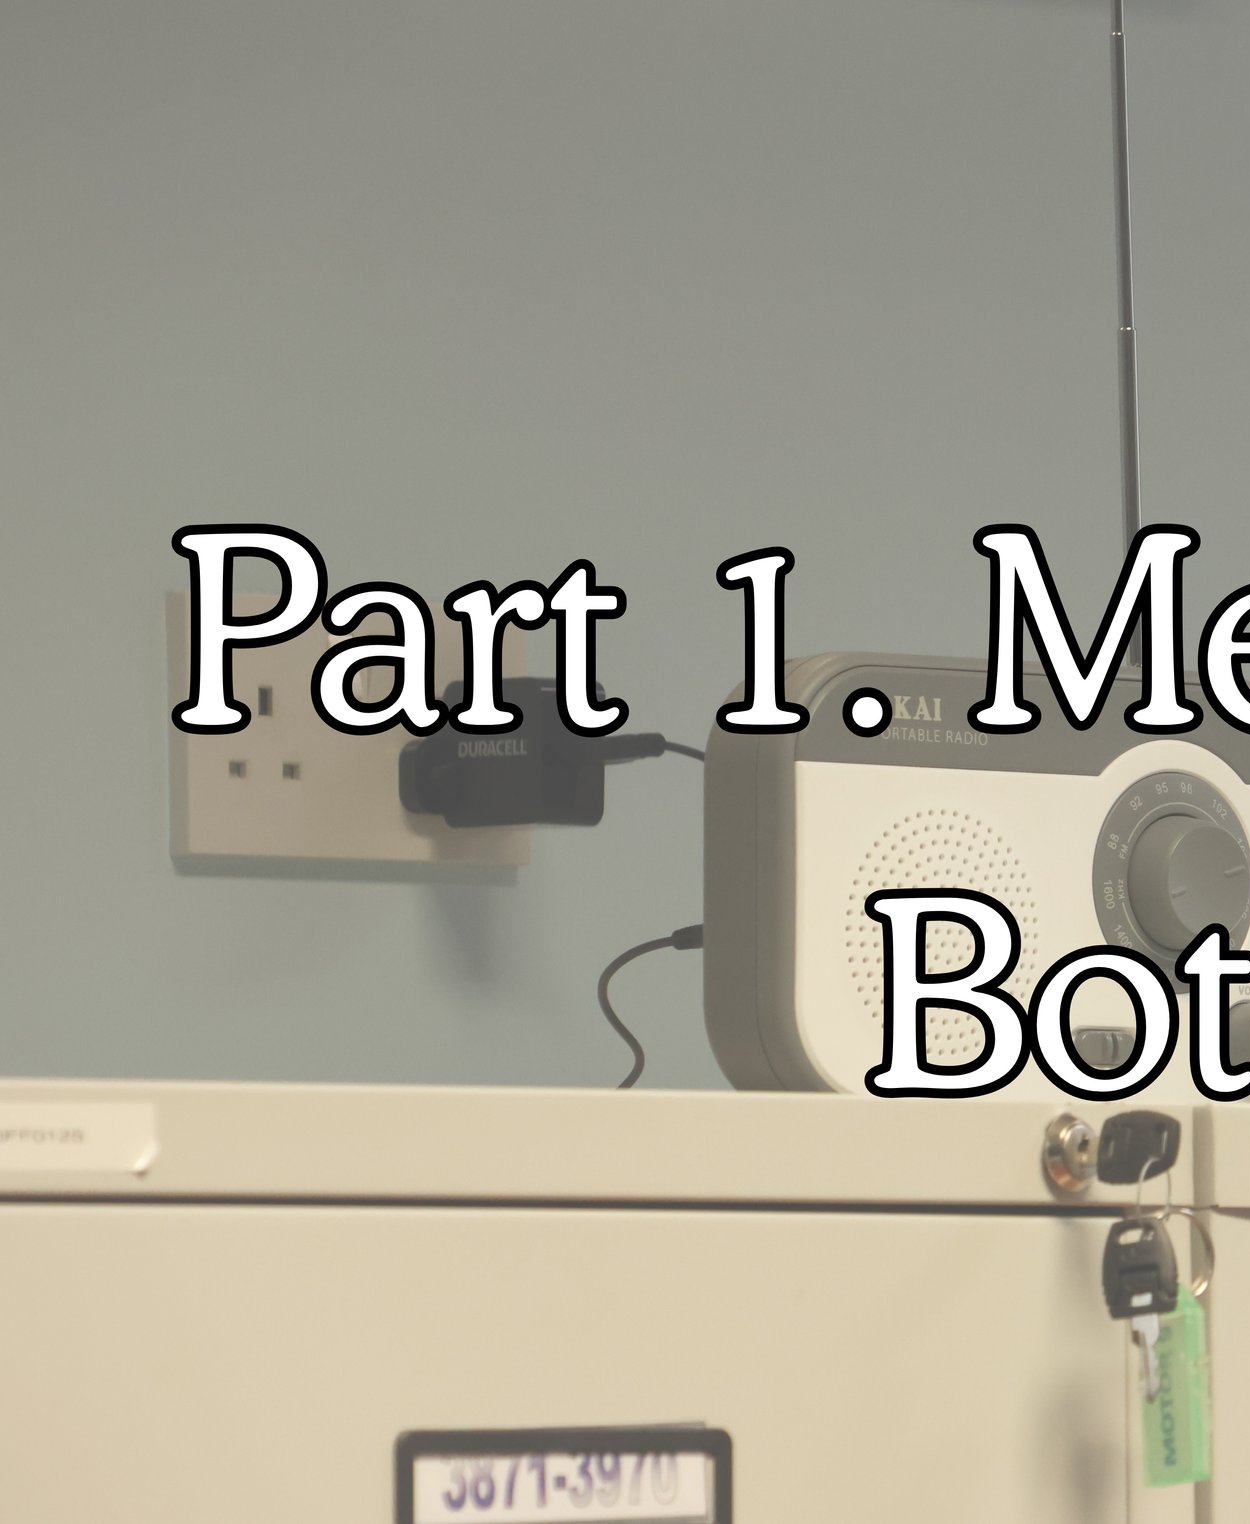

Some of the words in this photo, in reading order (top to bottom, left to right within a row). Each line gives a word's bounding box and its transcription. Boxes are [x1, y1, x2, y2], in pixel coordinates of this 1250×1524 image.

[893, 695, 942, 721] KAI
[458, 739, 527, 758] DURACELL
[882, 726, 941, 742] ORTABLE
[945, 729, 989, 746] RADIO
[1107, 833, 1119, 850] 88
[1129, 796, 1143, 811] 92
[1155, 782, 1169, 795] 95
[1211, 799, 1227, 820] 102
[1119, 844, 1129, 860] FM
[1103, 880, 1115, 910] 1600
[441, 1453, 679, 1513] 3871-3970
